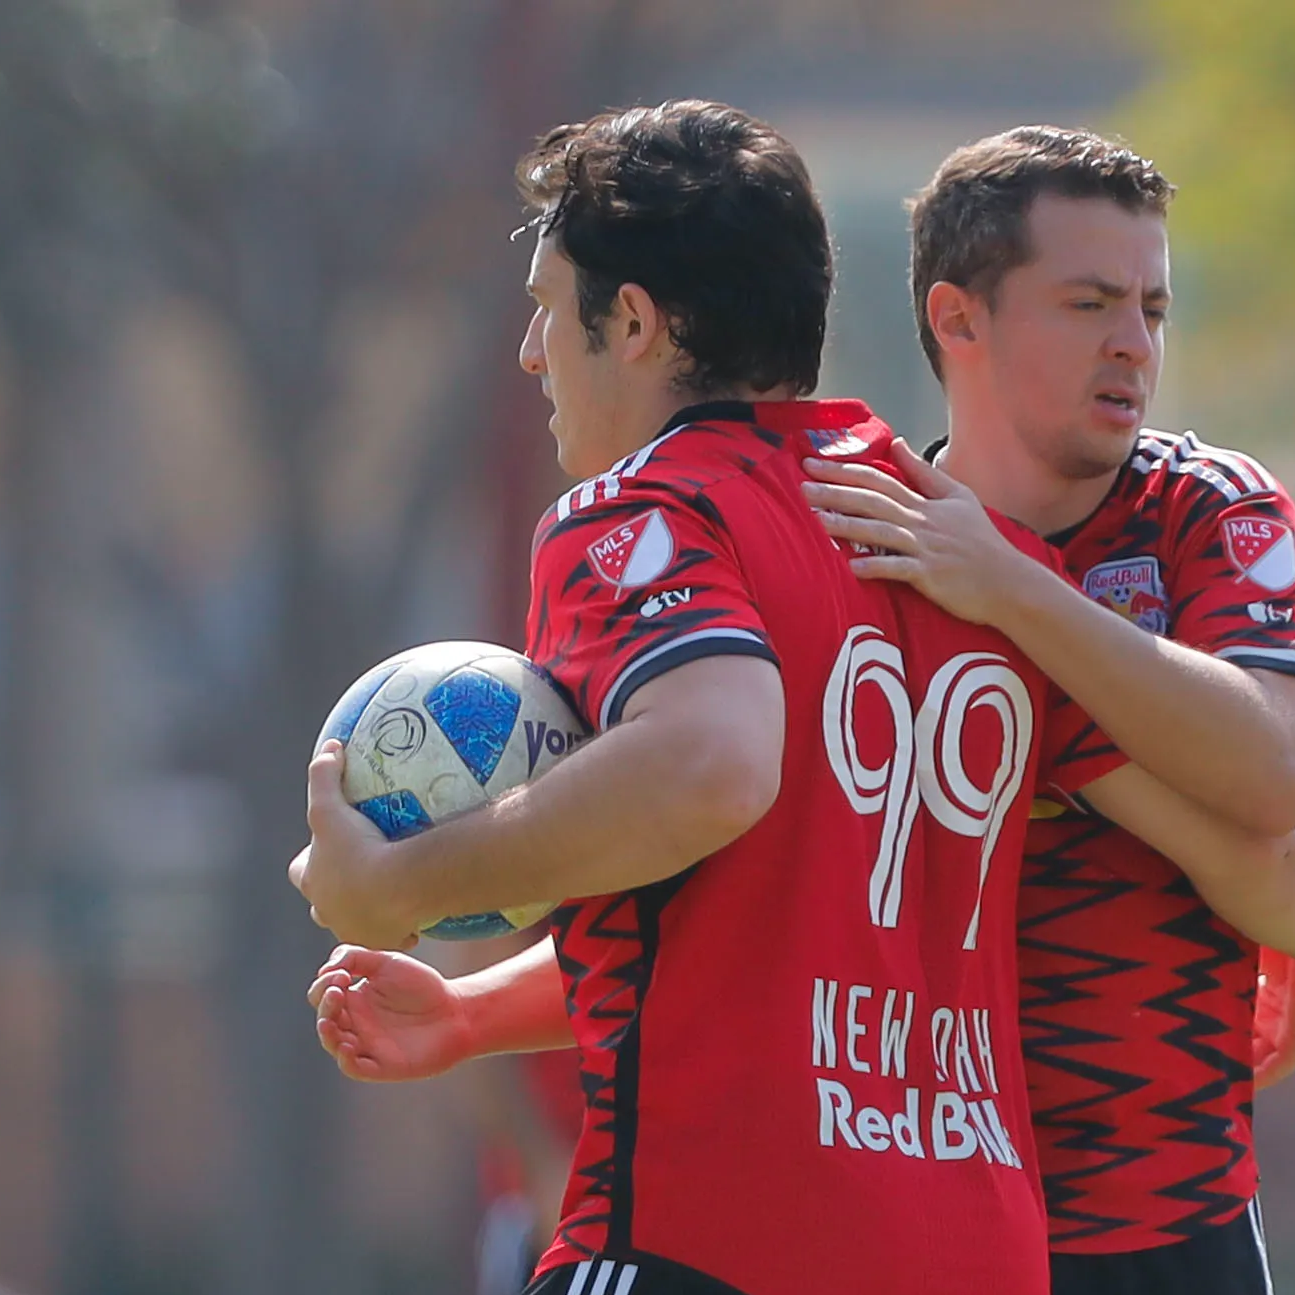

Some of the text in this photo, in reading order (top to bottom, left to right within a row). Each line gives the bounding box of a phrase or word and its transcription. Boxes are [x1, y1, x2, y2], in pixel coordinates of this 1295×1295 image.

[594, 526, 635, 560] MLS
[1230, 521, 1273, 539] MLS
[660, 587, 691, 608] tv
[822, 624, 1034, 951] 99
[812, 977, 916, 1080] NEW
[815, 1077, 926, 1159] Red
